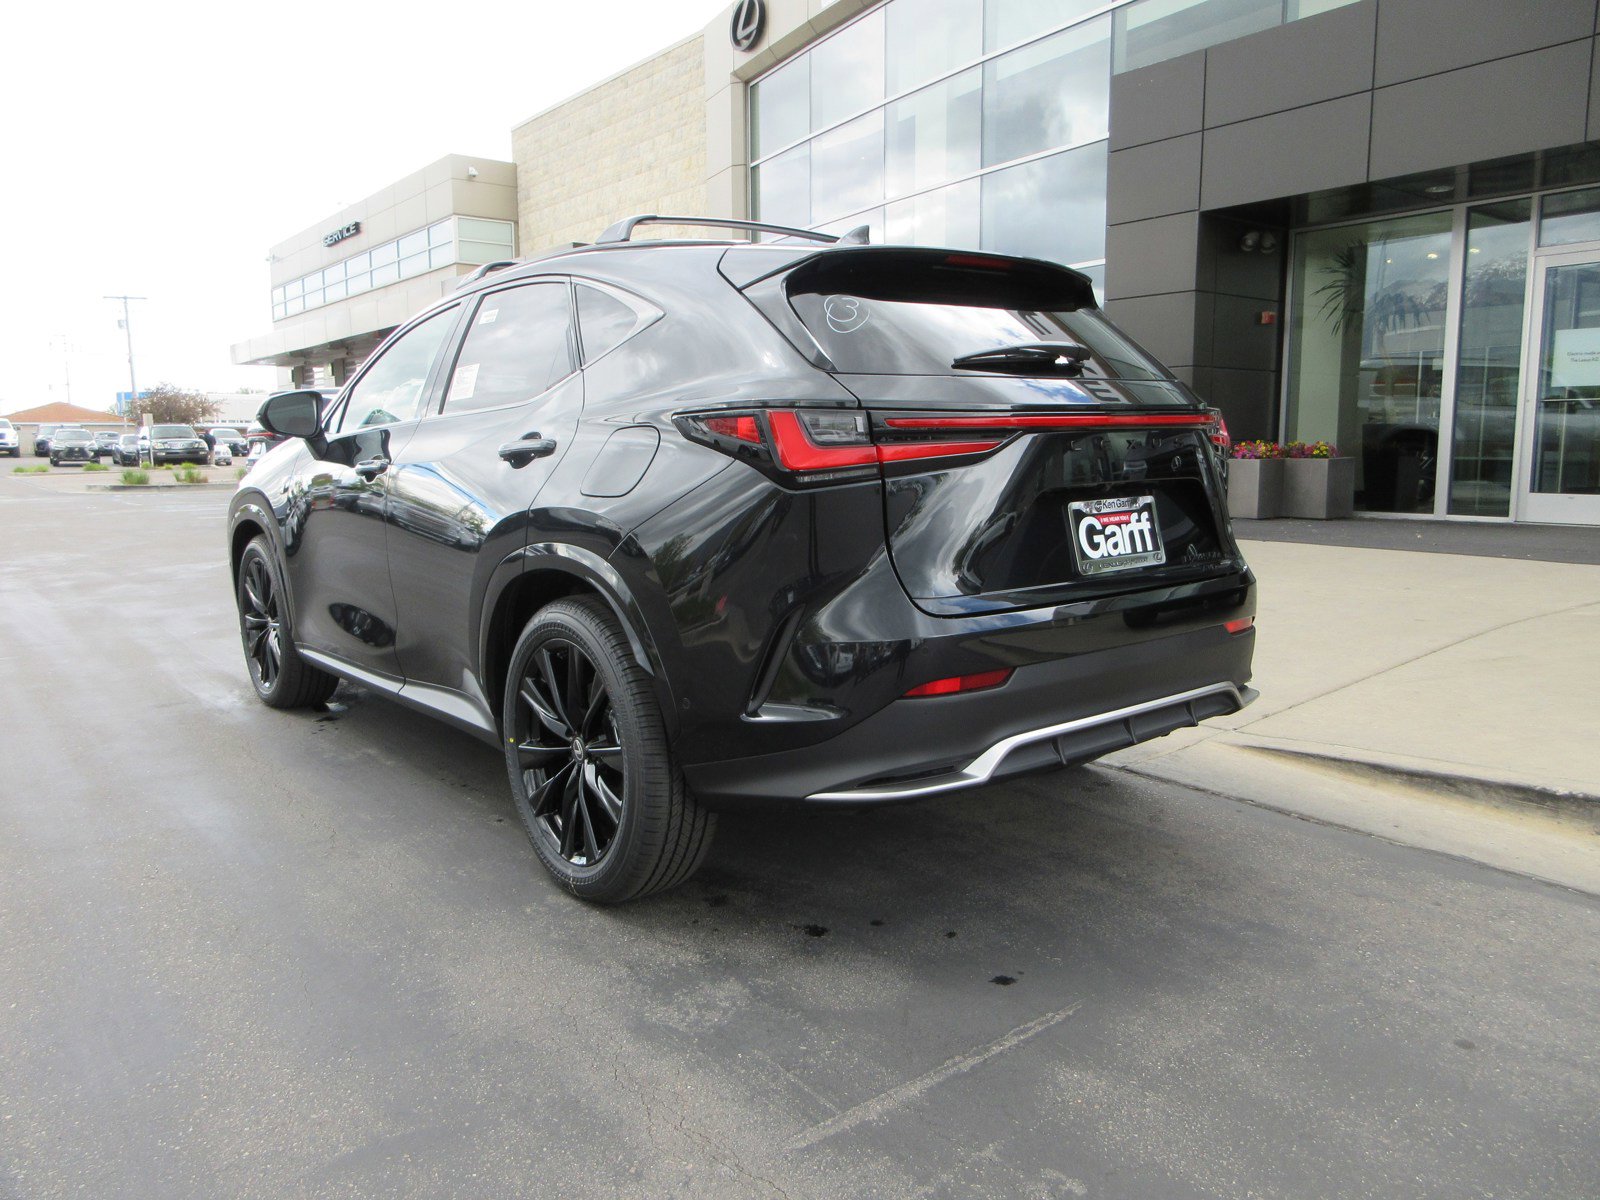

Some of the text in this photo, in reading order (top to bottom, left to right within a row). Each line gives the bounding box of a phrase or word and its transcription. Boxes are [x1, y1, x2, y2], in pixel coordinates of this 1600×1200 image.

[323, 221, 361, 247] SERVICE
[1102, 499, 1116, 509] Ken
[1079, 511, 1153, 559] Garff
